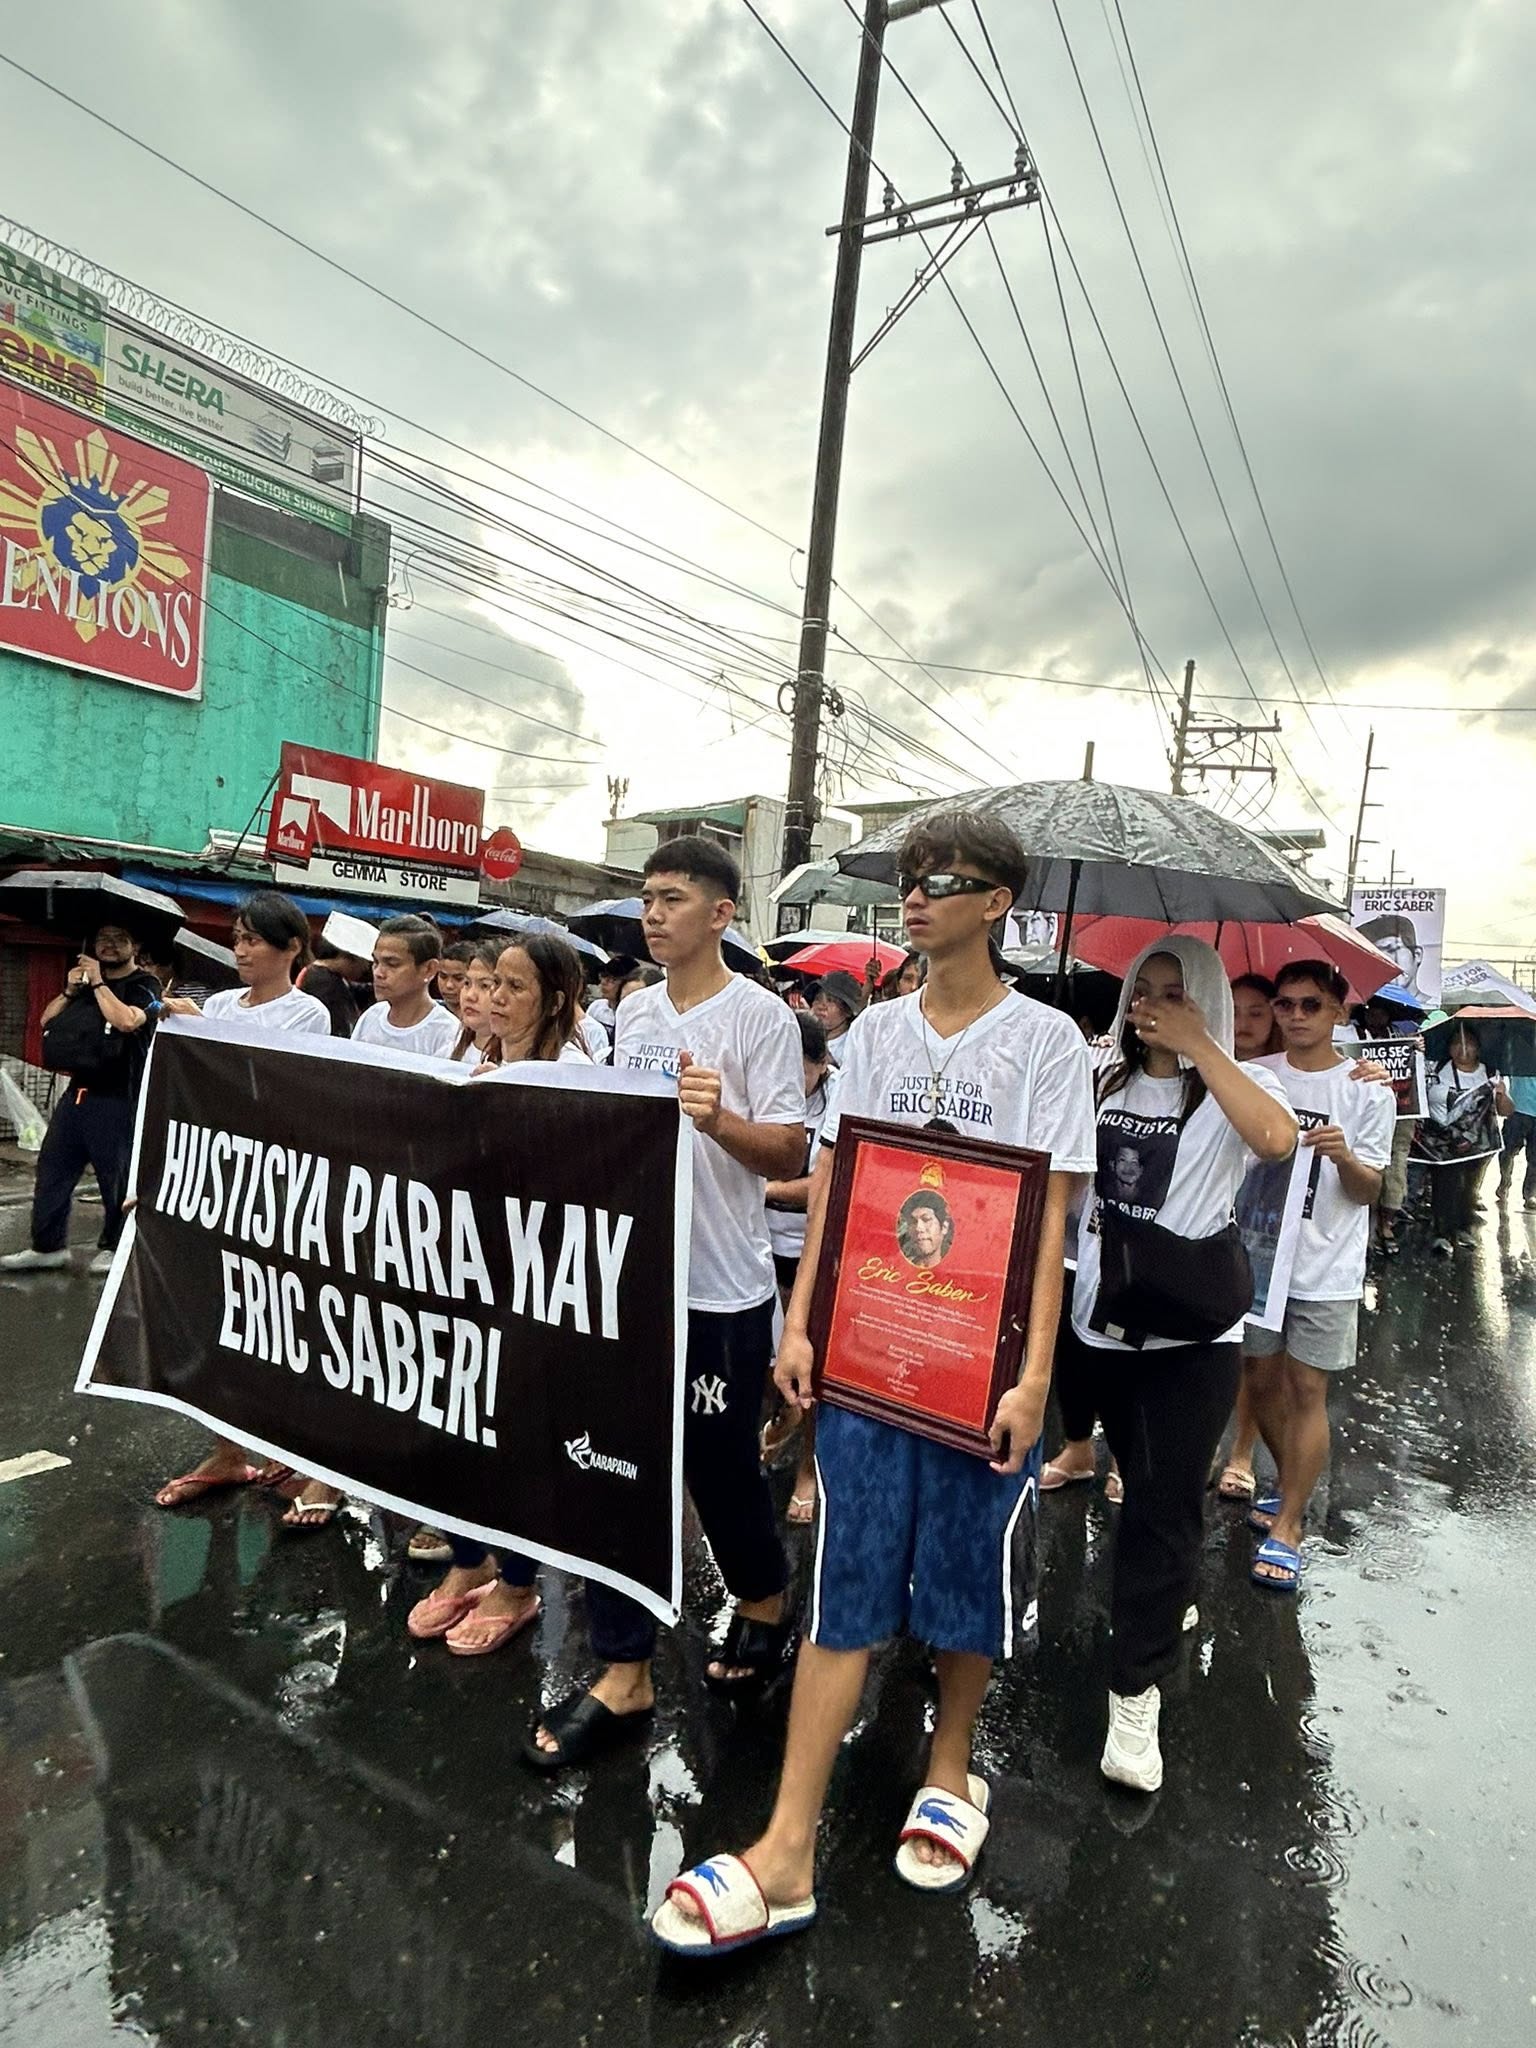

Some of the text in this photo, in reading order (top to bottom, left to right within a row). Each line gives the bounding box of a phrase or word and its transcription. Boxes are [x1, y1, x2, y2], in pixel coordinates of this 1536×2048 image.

[25, 293, 89, 334] FITTINGS
[121, 343, 224, 416] SHERA
[118, 374, 224, 432] build better, live better
[293, 494, 337, 522] SUPPLY
[354, 784, 479, 857] Marlboro
[332, 861, 388, 884] GEMMA
[400, 872, 448, 892] STORE
[1361, 890, 1436, 900] JUSTICE FOR
[1364, 900, 1434, 912] ERIC SABER
[638, 1043, 676, 1060] JUSTICE
[1362, 1045, 1410, 1059] DILG SEC
[956, 1080, 983, 1099] FOR
[890, 1092, 993, 1127] ERIC SABER
[1099, 1113, 1178, 1136] HUSTISYA
[155, 1119, 634, 1340] HUSTISYA PARA KAY
[857, 1257, 989, 1303] Eric Saber
[218, 1249, 502, 1448] ERIC SABER!
[691, 1373, 728, 1415] NY
[589, 1452, 638, 1481] KARAPATAN
